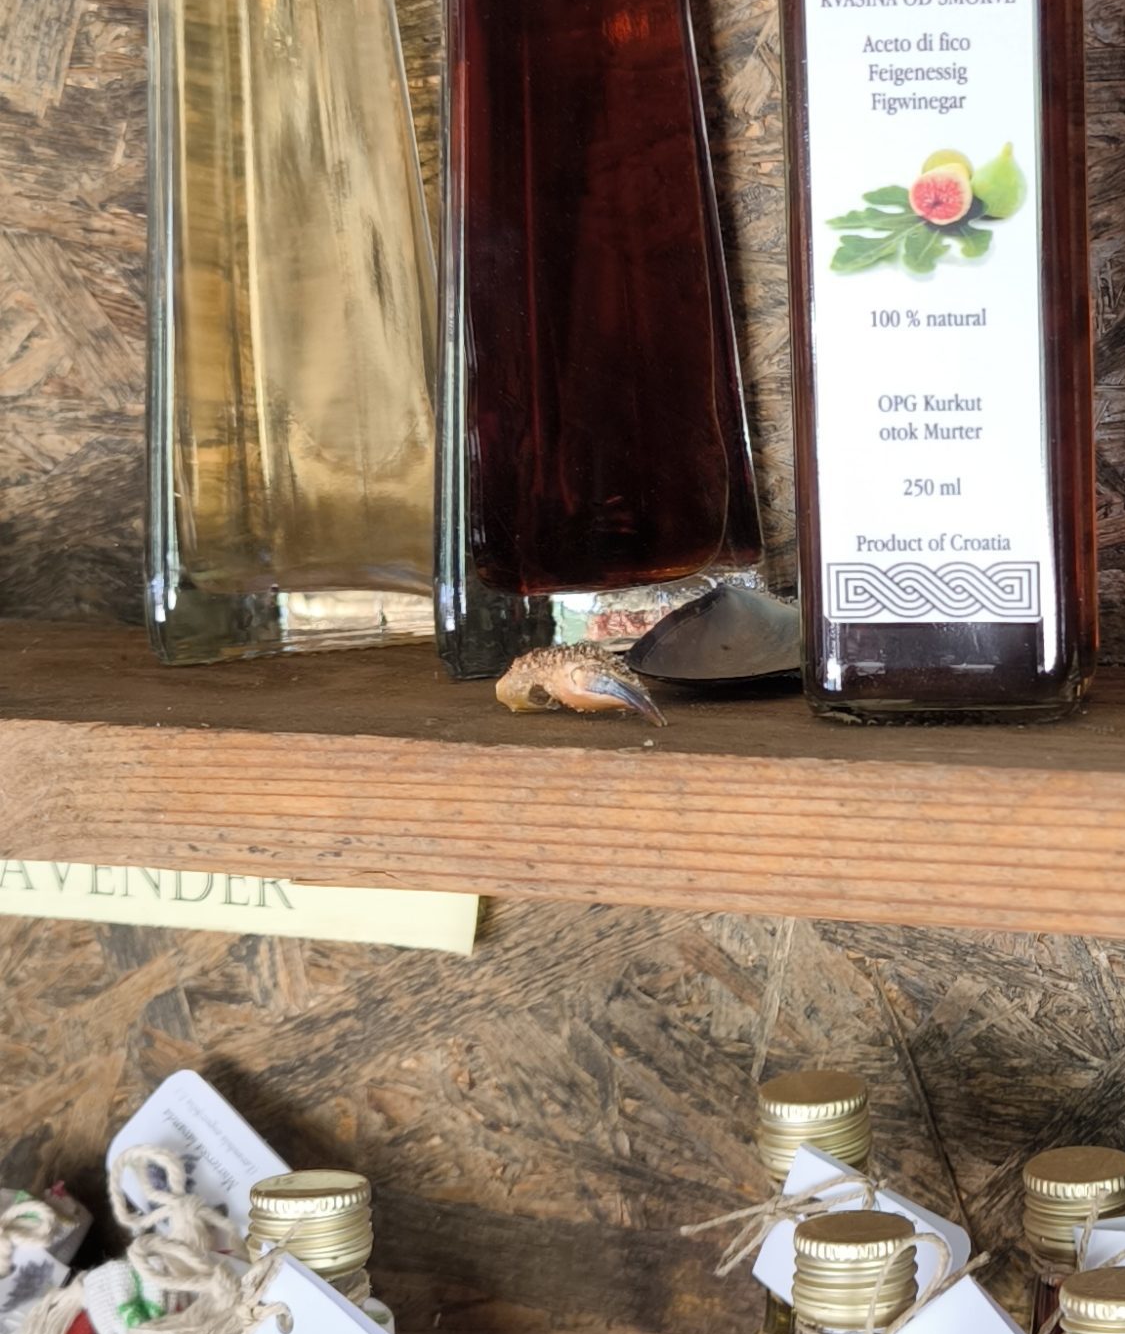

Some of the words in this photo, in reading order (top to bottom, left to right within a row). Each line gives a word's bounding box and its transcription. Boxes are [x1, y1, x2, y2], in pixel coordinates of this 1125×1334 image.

[862, 35, 911, 53] Aceto
[916, 33, 934, 52] di
[938, 32, 971, 51] fico
[868, 63, 968, 86] Feigenessig
[871, 92, 967, 116] Figwinegar
[926, 308, 987, 327] natural
[877, 395, 917, 413] OPG
[923, 394, 983, 412] Kurkut
[879, 423, 918, 441] otok
[924, 423, 983, 440] Murter
[903, 478, 934, 497] 250
[939, 478, 962, 496] ml
[856, 534, 923, 553] Product
[928, 533, 947, 552] of
[950, 533, 1012, 552] Croatia
